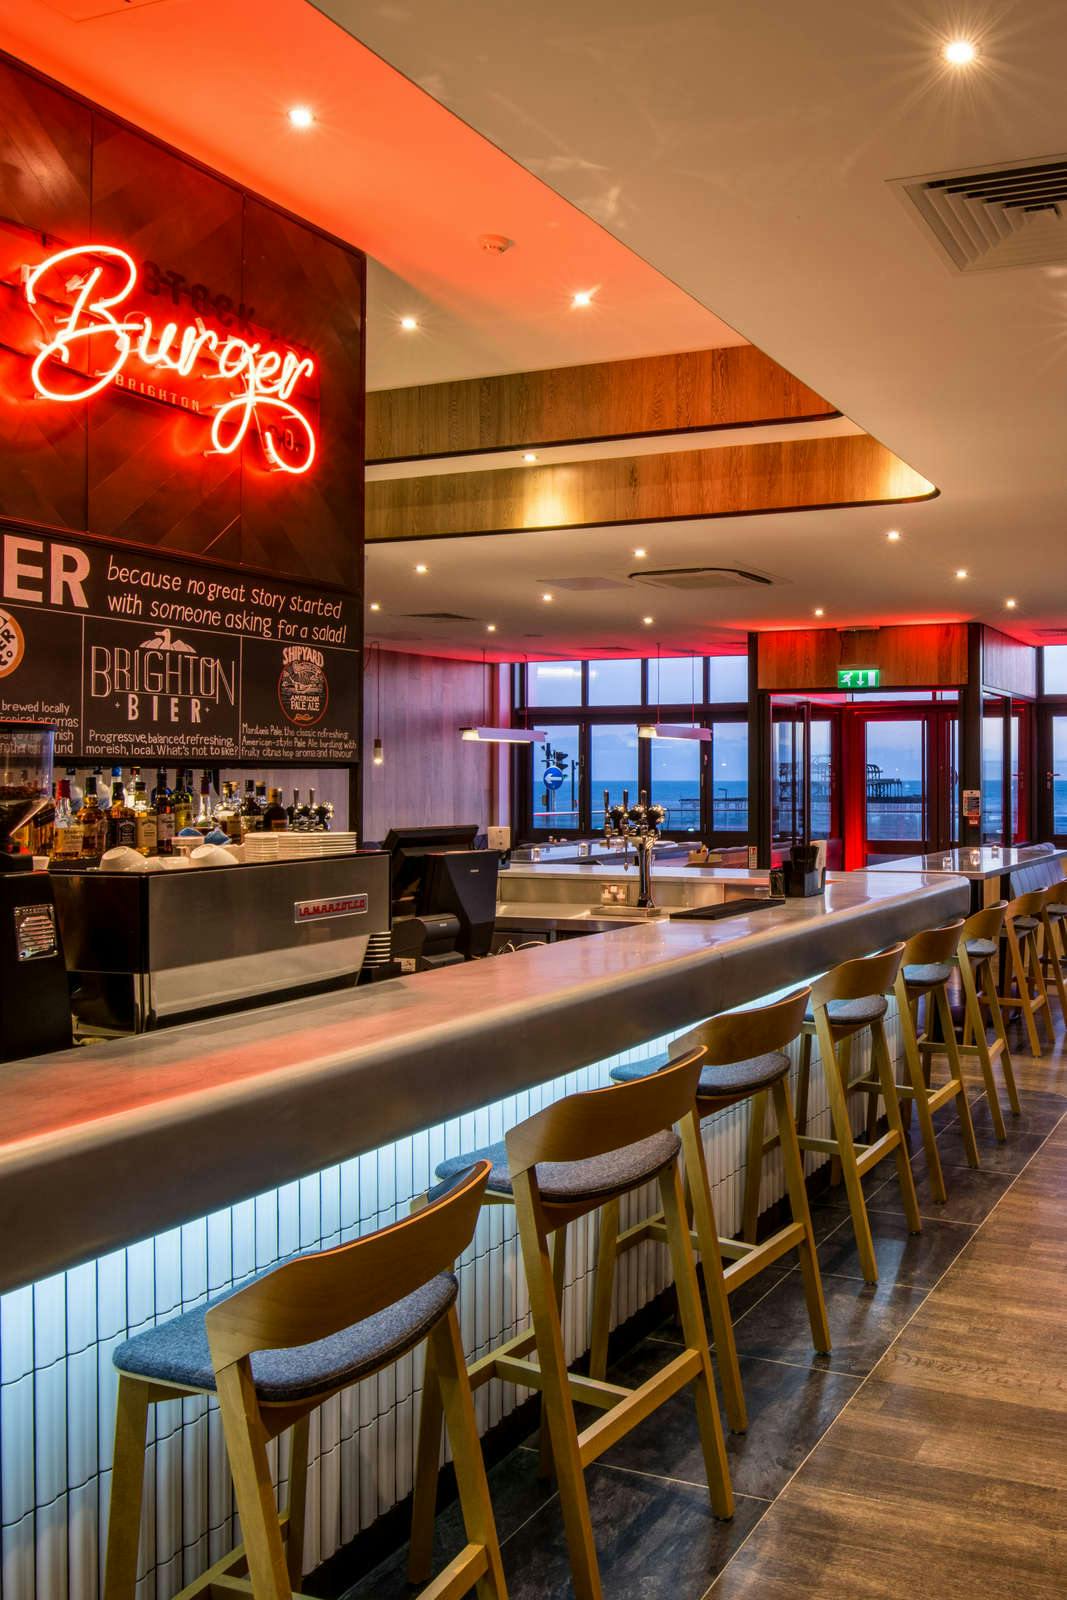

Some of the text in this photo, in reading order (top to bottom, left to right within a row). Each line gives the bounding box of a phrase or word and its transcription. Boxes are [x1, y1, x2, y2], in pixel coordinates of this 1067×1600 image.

[26, 244, 315, 474] Burger
[115, 374, 200, 412] BRIGHTON
[3, 534, 91, 609] ER
[107, 554, 182, 592] because
[186, 579, 206, 596] no
[207, 583, 246, 603] great
[289, 595, 343, 619] started
[107, 593, 347, 643] with someone asking for a salad!
[282, 645, 325, 668] SHIPYARD
[91, 646, 235, 706] BRIGHTON
[1, 699, 71, 716] brewed locally
[127, 693, 202, 724] BIER
[290, 695, 320, 703] AMERICAN
[290, 700, 320, 711] PALE ALE
[86, 743, 129, 756] moreish,
[131, 744, 156, 756] local.
[157, 744, 190, 756] What's
[191, 745, 209, 756] not
[210, 745, 220, 756] to
